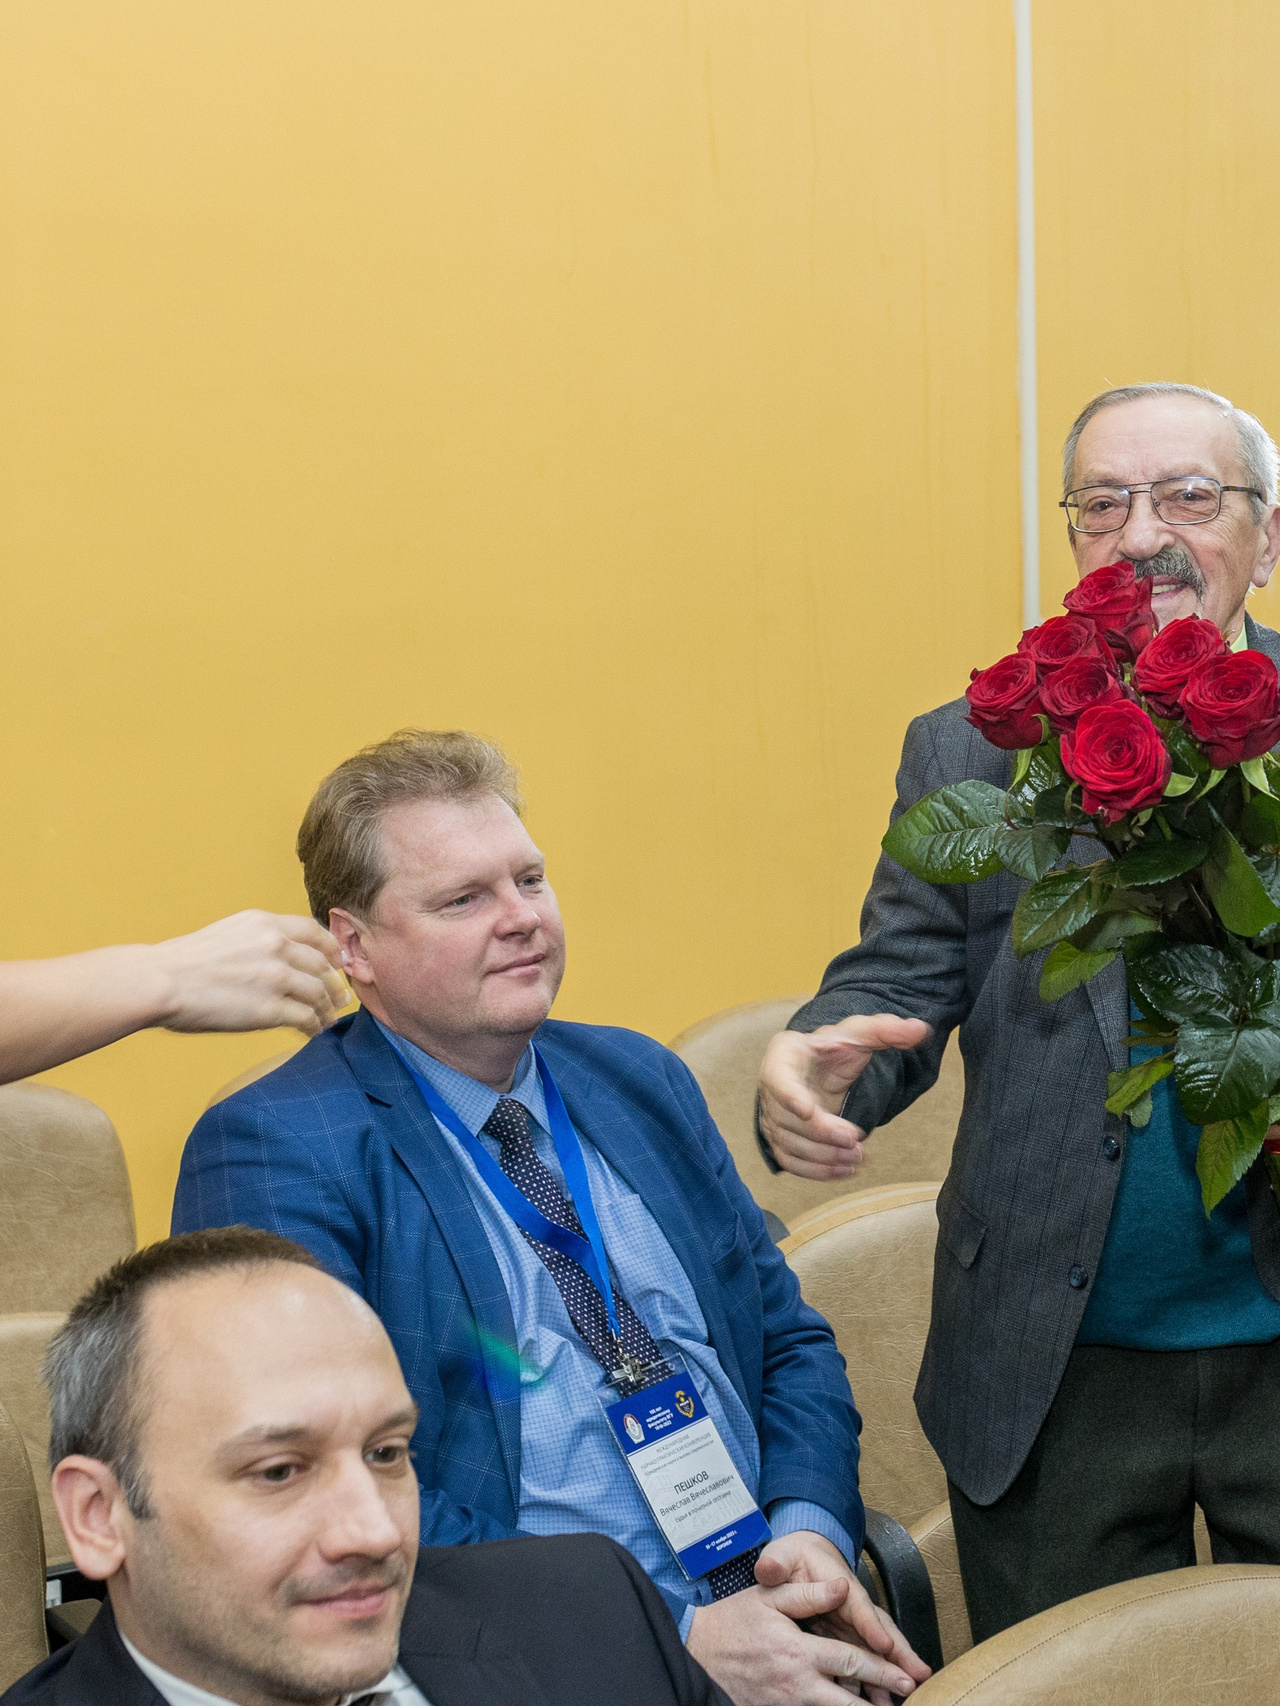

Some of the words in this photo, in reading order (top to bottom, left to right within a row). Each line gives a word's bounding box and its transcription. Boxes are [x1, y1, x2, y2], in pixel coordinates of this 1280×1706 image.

[659, 1494, 691, 1517] Вячеслав
[689, 1472, 734, 1501] Вячеславович
[673, 1470, 709, 1494] ПЕШКОВ
